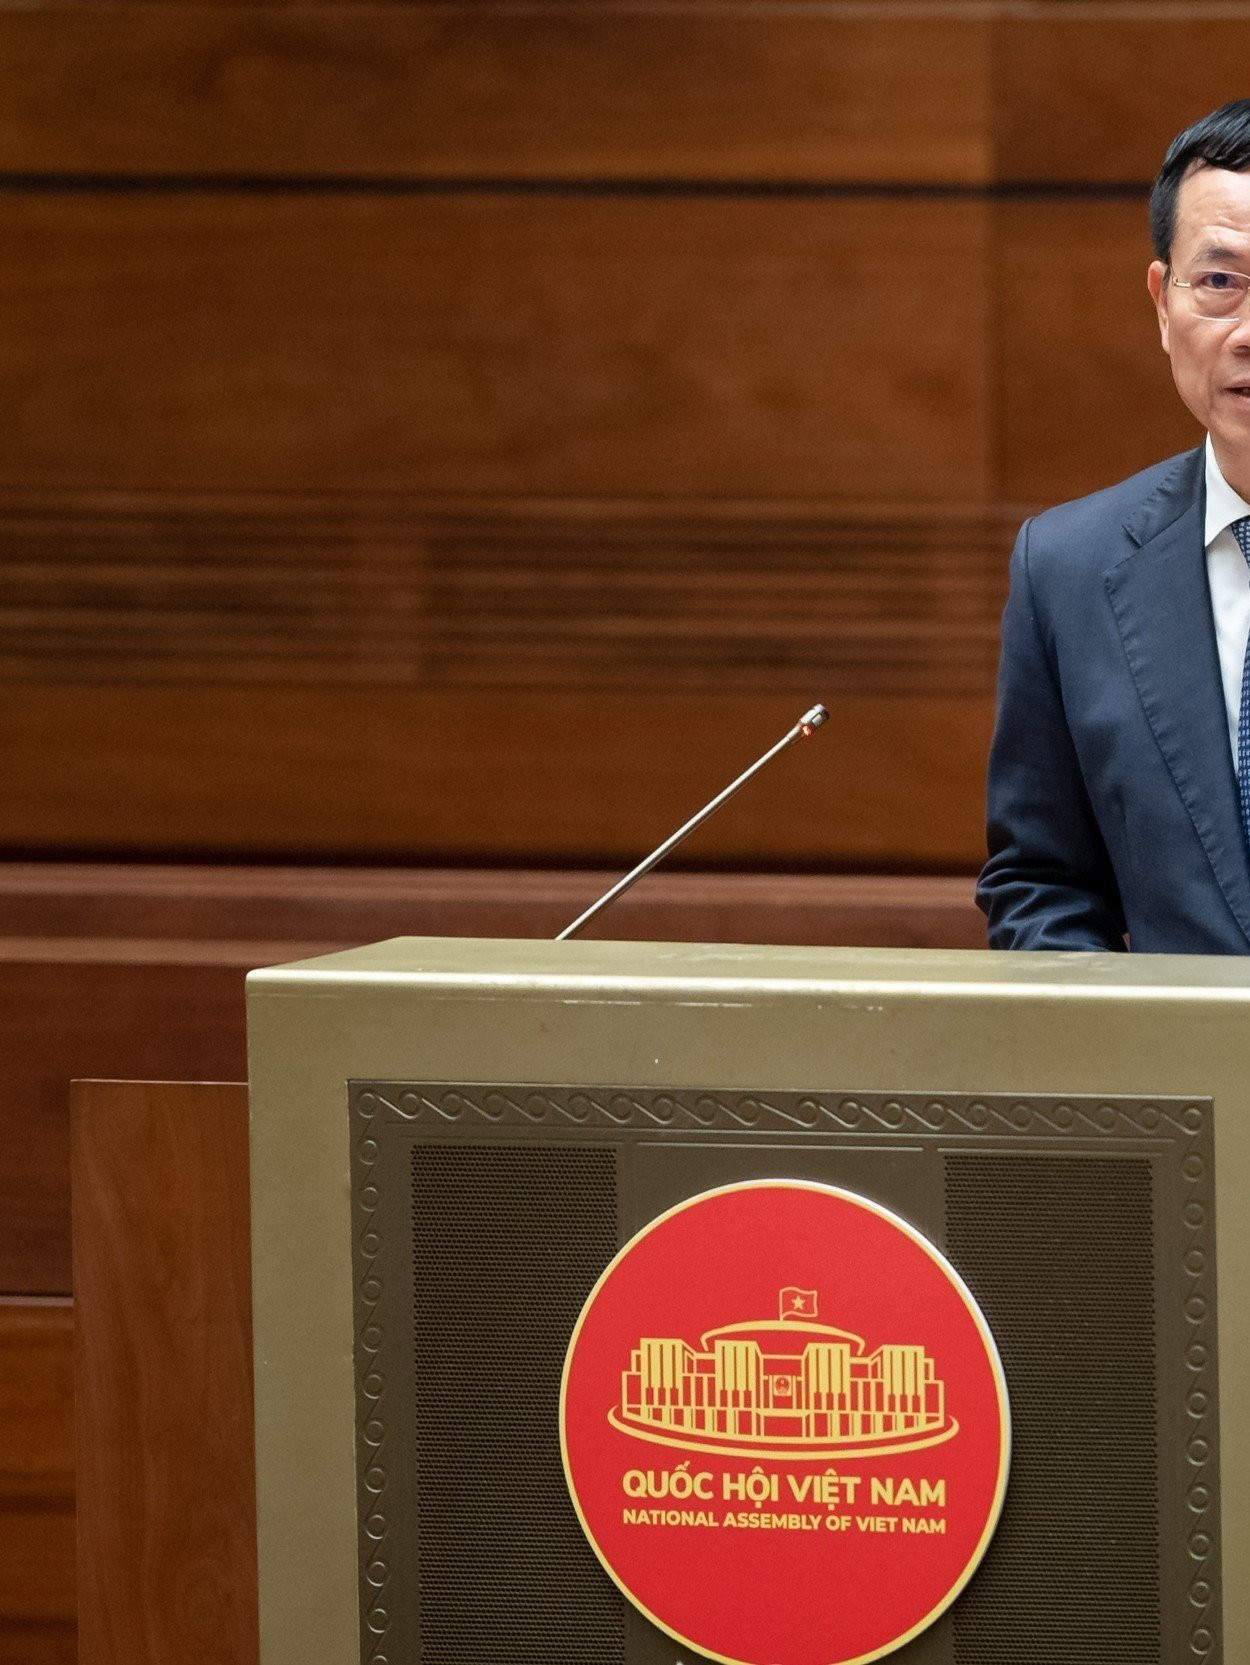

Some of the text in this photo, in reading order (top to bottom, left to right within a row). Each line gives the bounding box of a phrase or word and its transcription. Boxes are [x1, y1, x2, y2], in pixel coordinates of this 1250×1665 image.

[622, 1460, 946, 1511] QUỐC HỘI VIỆT NAM
[622, 1508, 946, 1534] NATIONAL ASSEMBLY OF VIET NAM
